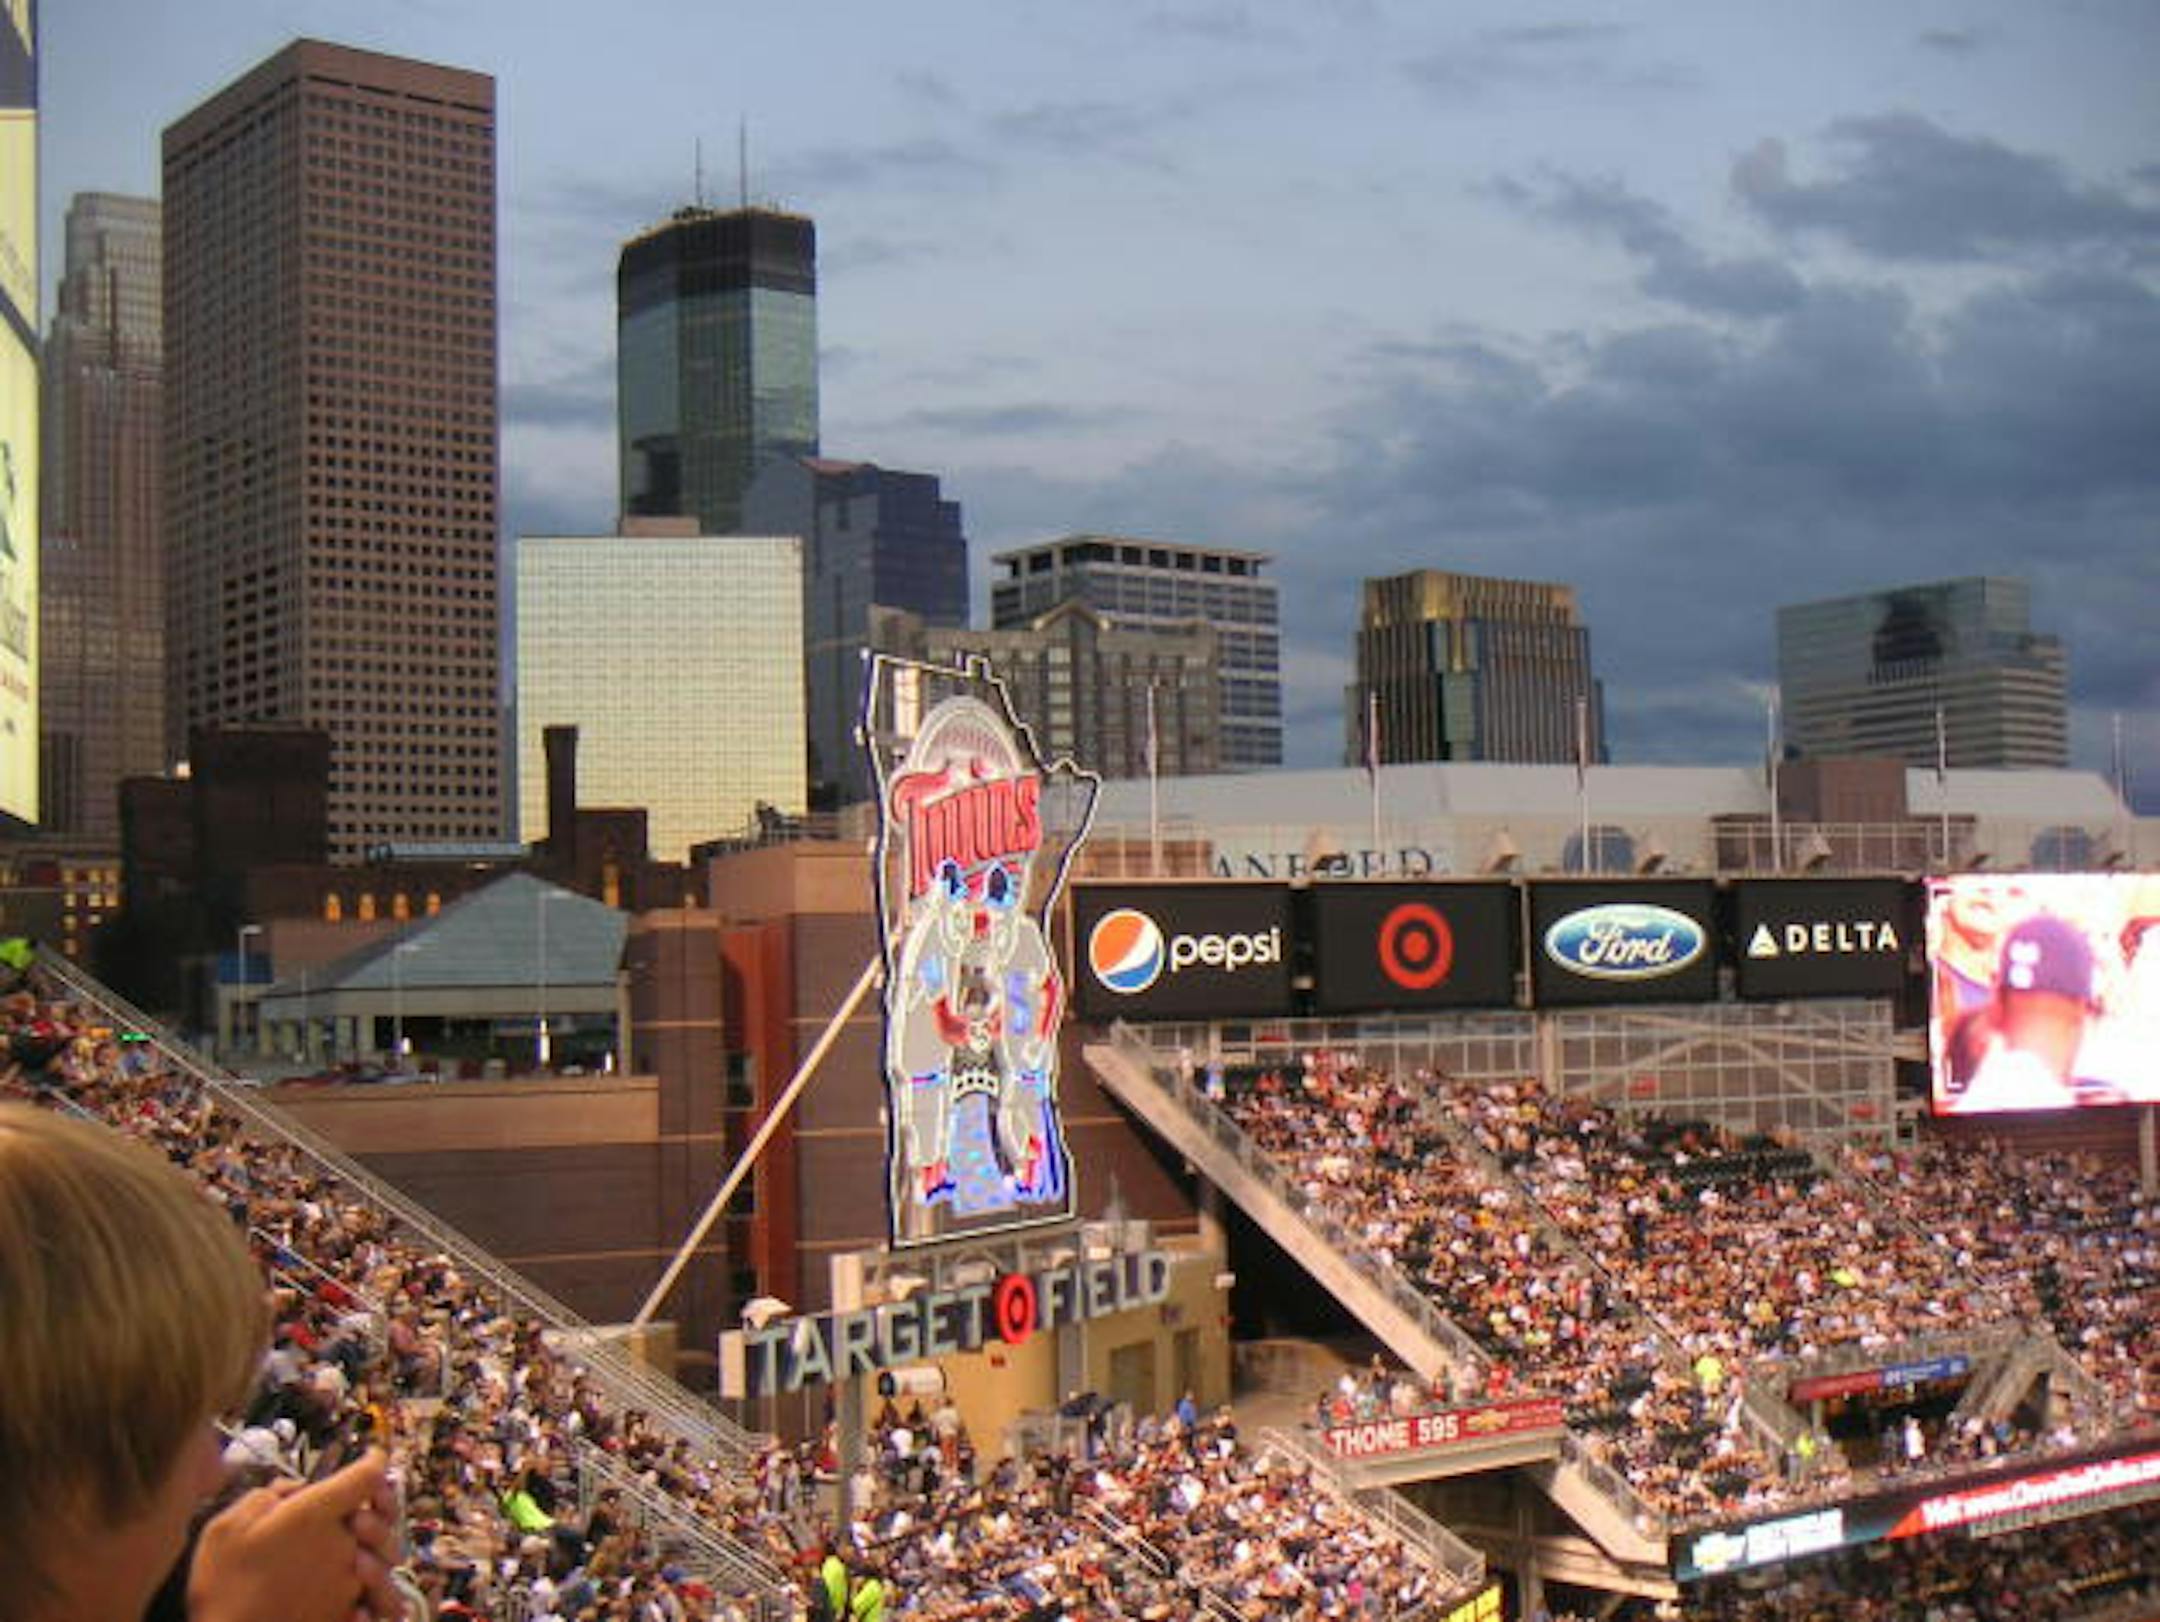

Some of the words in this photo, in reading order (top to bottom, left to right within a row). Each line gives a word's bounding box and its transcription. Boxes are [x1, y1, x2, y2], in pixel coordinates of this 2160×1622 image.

[1170, 926, 1282, 973] pepsi
[1578, 921, 1676, 965] Ford
[1784, 921, 1899, 953] DELTA
[755, 1286, 989, 1396] TARGET
[1040, 1252, 1169, 1329] FIELD
[1416, 1413, 1461, 1445] 595
